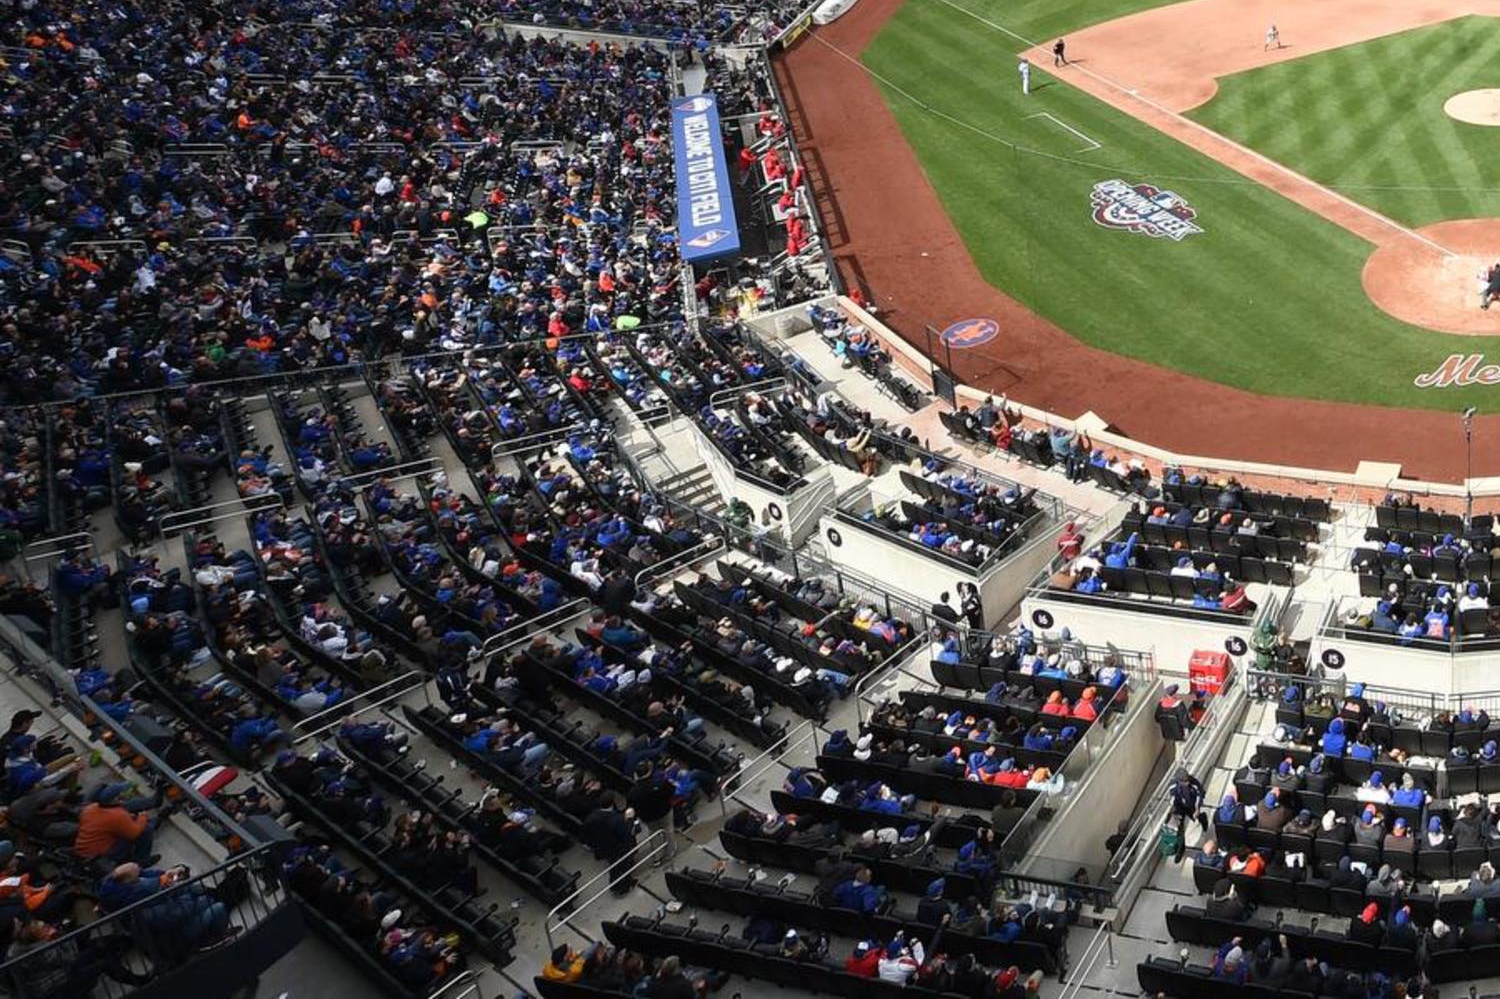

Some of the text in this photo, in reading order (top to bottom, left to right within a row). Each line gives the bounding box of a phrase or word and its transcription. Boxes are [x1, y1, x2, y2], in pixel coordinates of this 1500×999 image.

[683, 113, 713, 159] WELCOME
[687, 156, 715, 173] TO
[691, 191, 722, 227] FIELD
[1231, 642, 1241, 652] 16
